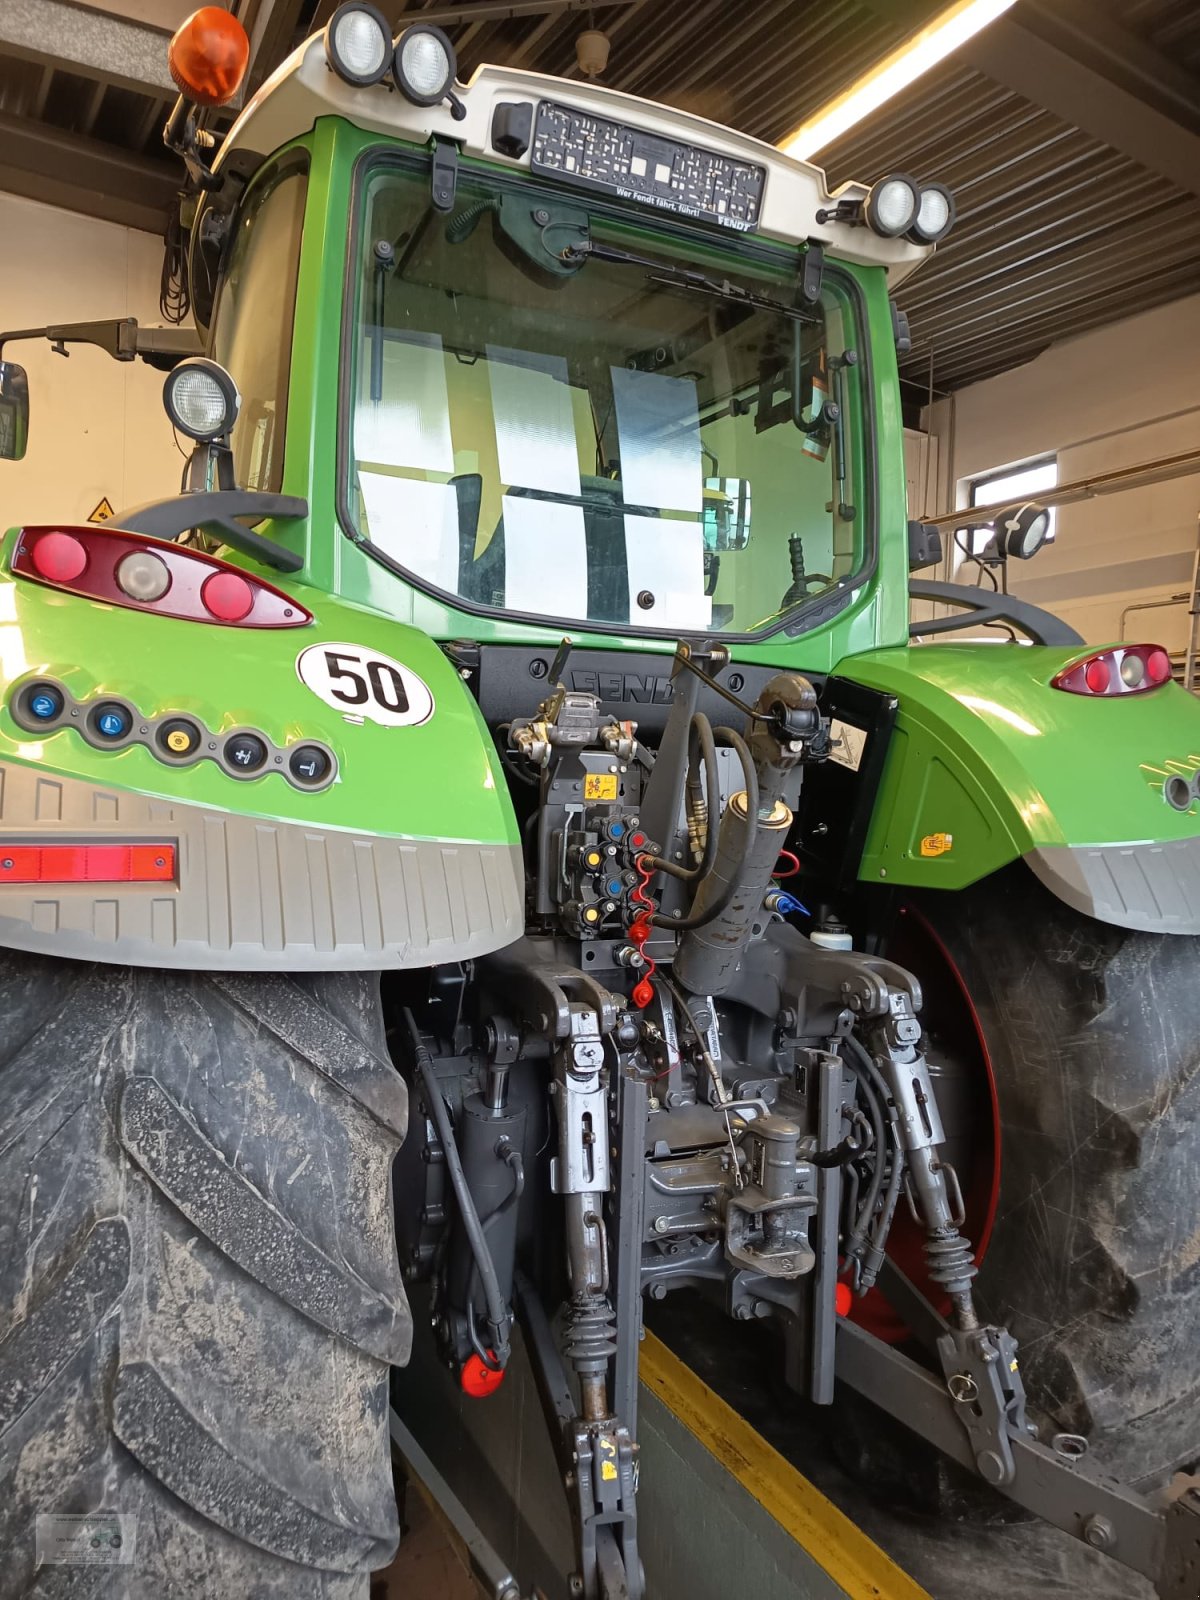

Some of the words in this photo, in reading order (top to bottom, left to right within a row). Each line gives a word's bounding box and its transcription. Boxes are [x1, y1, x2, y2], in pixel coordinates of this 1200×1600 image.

[616, 187, 632, 199] Wer
[633, 192, 655, 205] Fendt
[656, 198, 677, 211] fährt,
[679, 204, 700, 217] führt!
[717, 215, 750, 232] FENDT
[324, 651, 410, 713] 50
[571, 670, 675, 705] FEND
